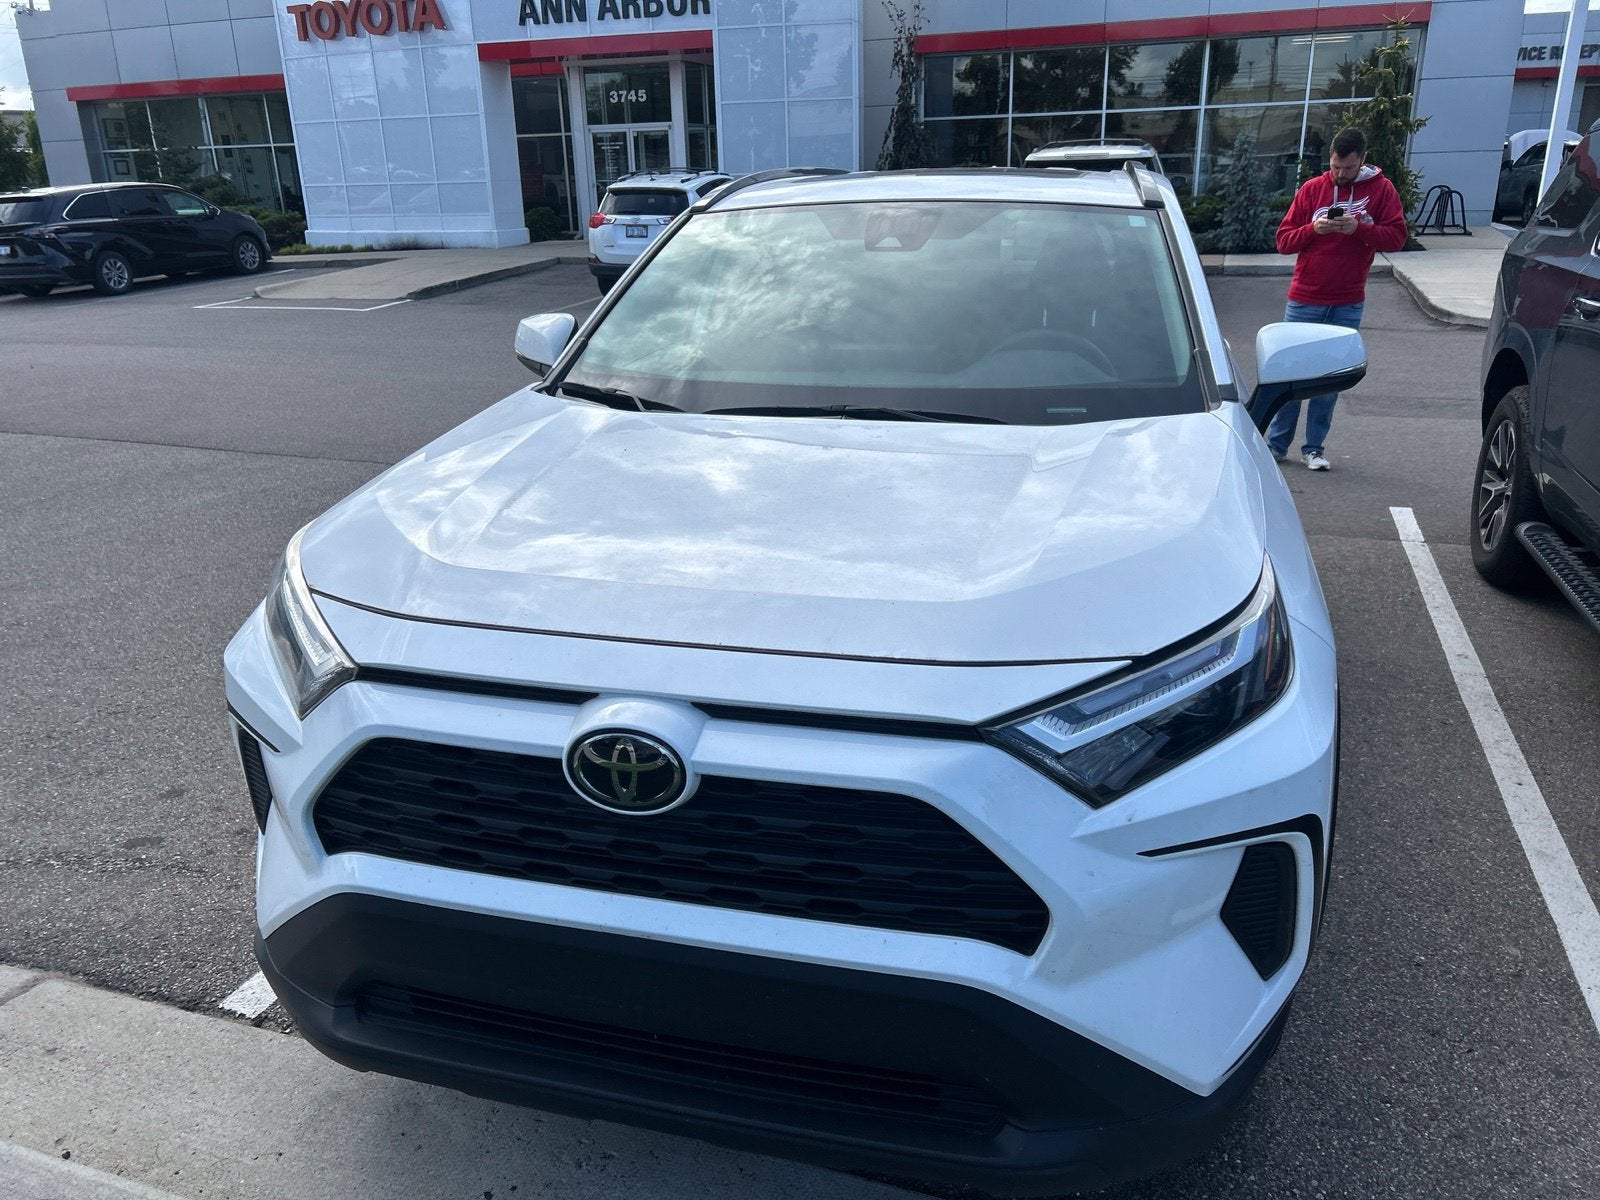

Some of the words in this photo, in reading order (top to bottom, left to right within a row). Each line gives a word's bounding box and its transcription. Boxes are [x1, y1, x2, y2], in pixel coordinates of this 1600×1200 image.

[286, 0, 448, 42] TOYOTA
[519, 0, 588, 26] ANN
[609, 89, 647, 103] 3745
